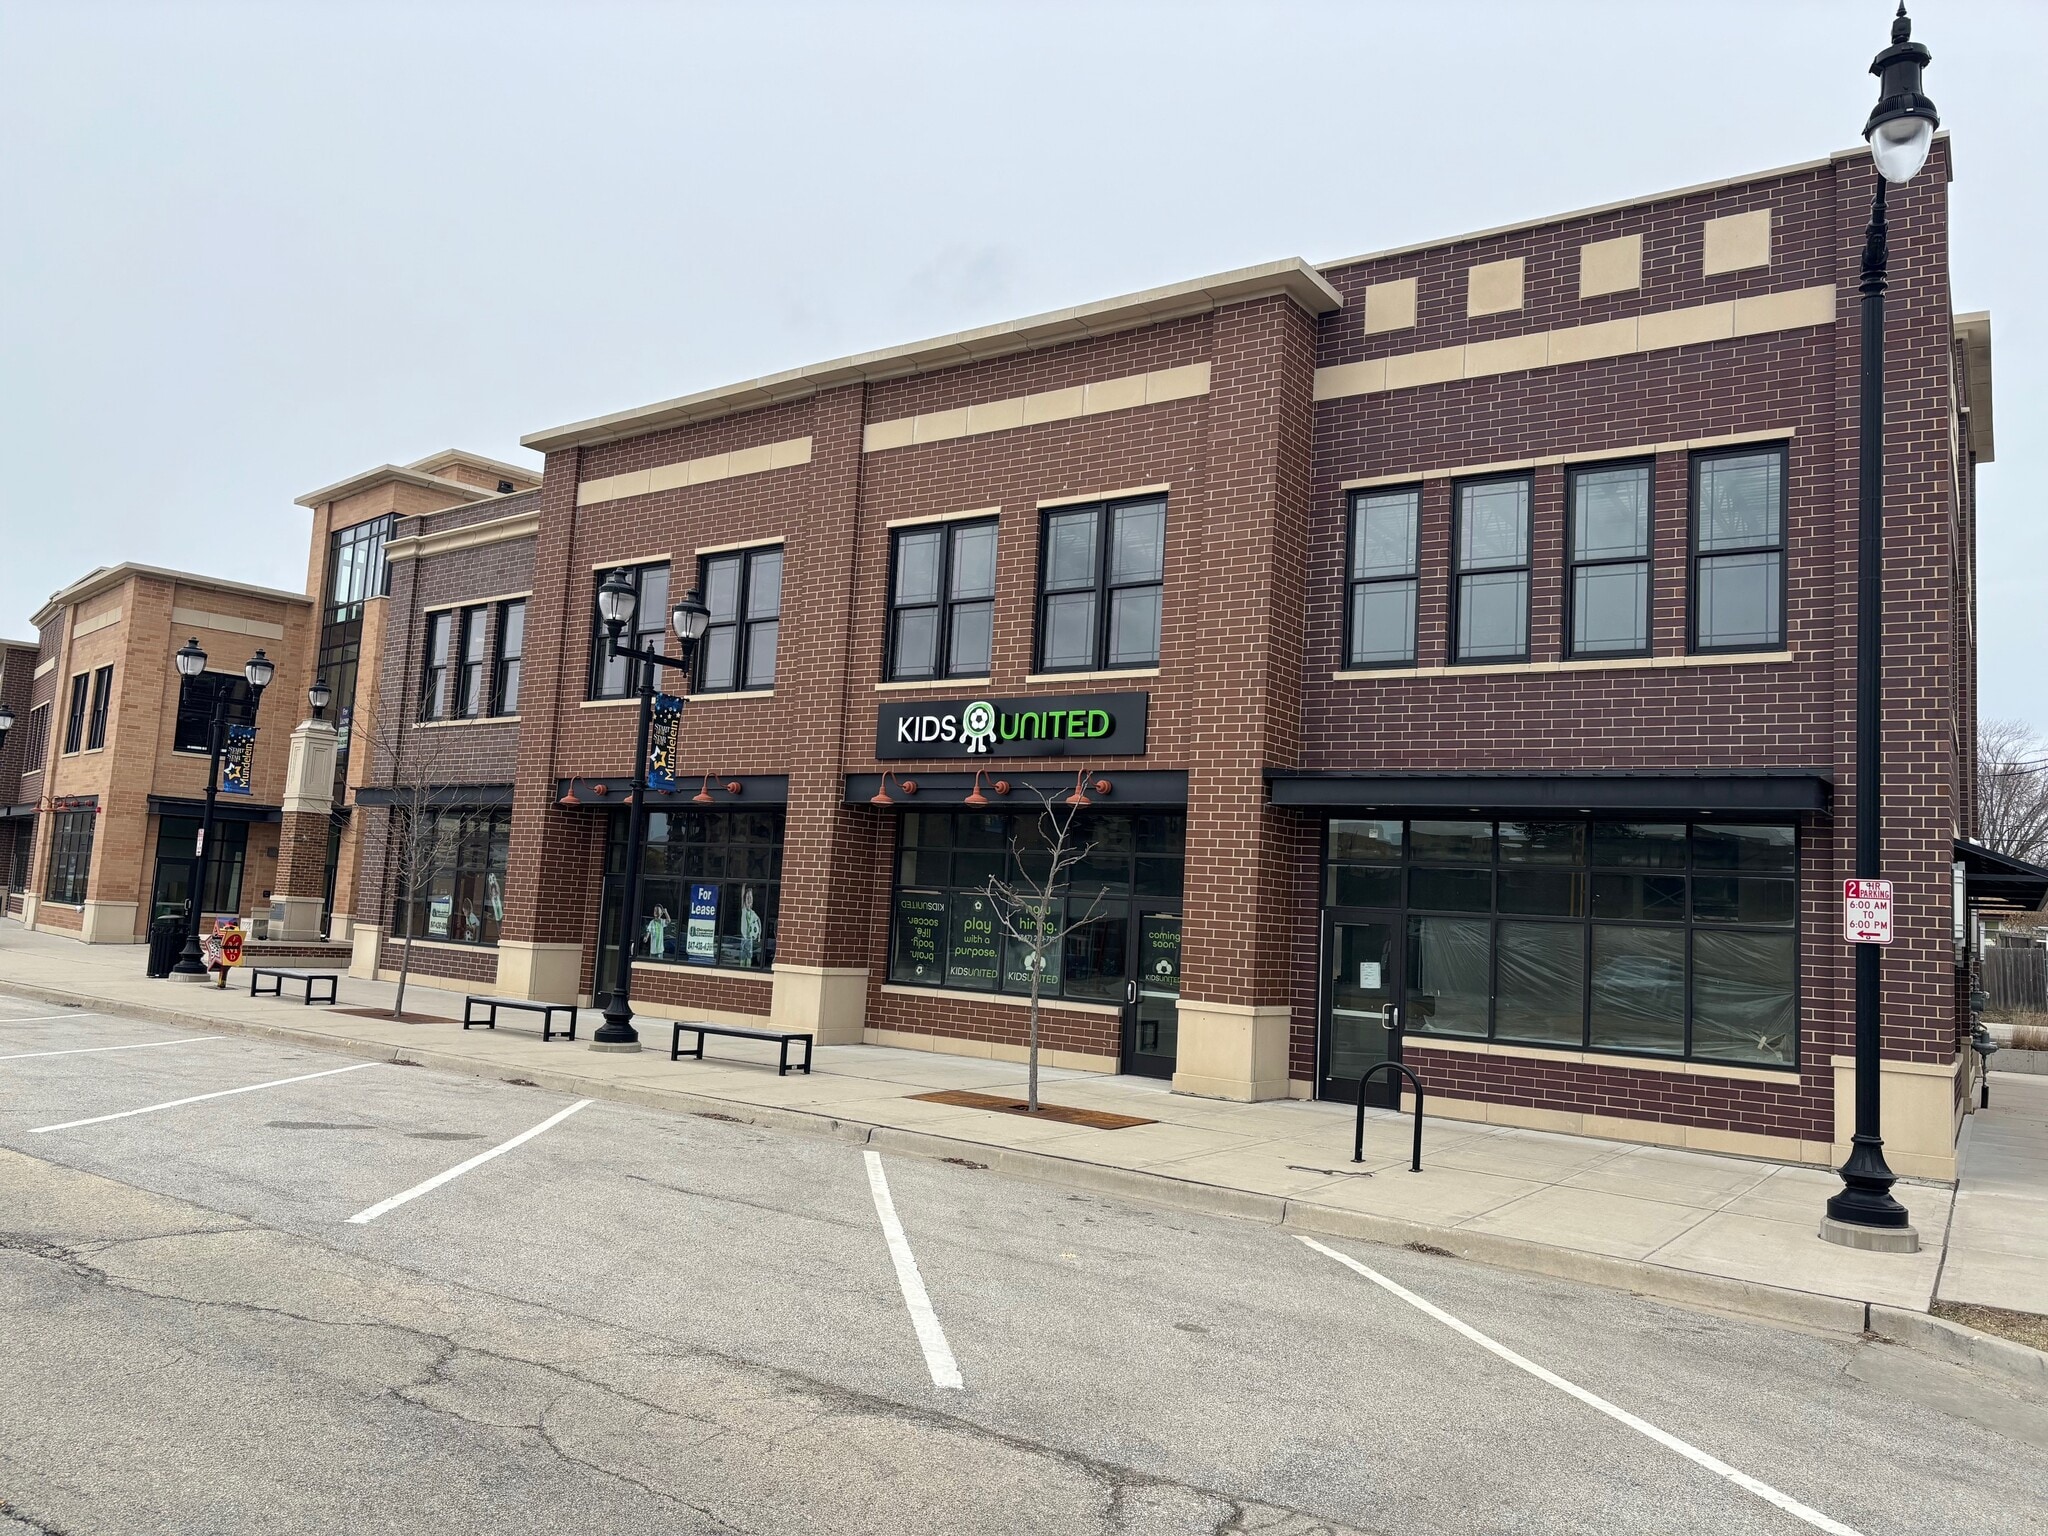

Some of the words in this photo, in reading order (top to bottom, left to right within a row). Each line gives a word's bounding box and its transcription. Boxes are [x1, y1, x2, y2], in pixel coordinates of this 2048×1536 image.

[898, 716, 956, 742] KIDS
[1001, 710, 1110, 740] UNITED
[664, 720, 678, 781] Mundelein
[240, 744, 252, 788] Mundelein
[698, 888, 712, 900] For
[1848, 882, 1856, 896] 2
[1860, 890, 1889, 899] PARKING
[691, 902, 715, 916] Lease
[1850, 901, 1870, 909] 6:00
[908, 916, 939, 926] soccer.
[1863, 911, 1874, 919] TO
[964, 917, 992, 934] play
[1020, 918, 1057, 934] hirng.
[1850, 920, 1870, 928] 6:00
[1874, 921, 1887, 929] PM
[915, 927, 931, 938] life.
[1149, 931, 1180, 942] coming
[911, 937, 934, 950] body.
[964, 935, 982, 944] with
[910, 950, 934, 963] brain.
[955, 947, 997, 958] purpose.
[950, 966, 998, 978] KIDSUNITED
[1008, 972, 1058, 984] KIDSUITED
